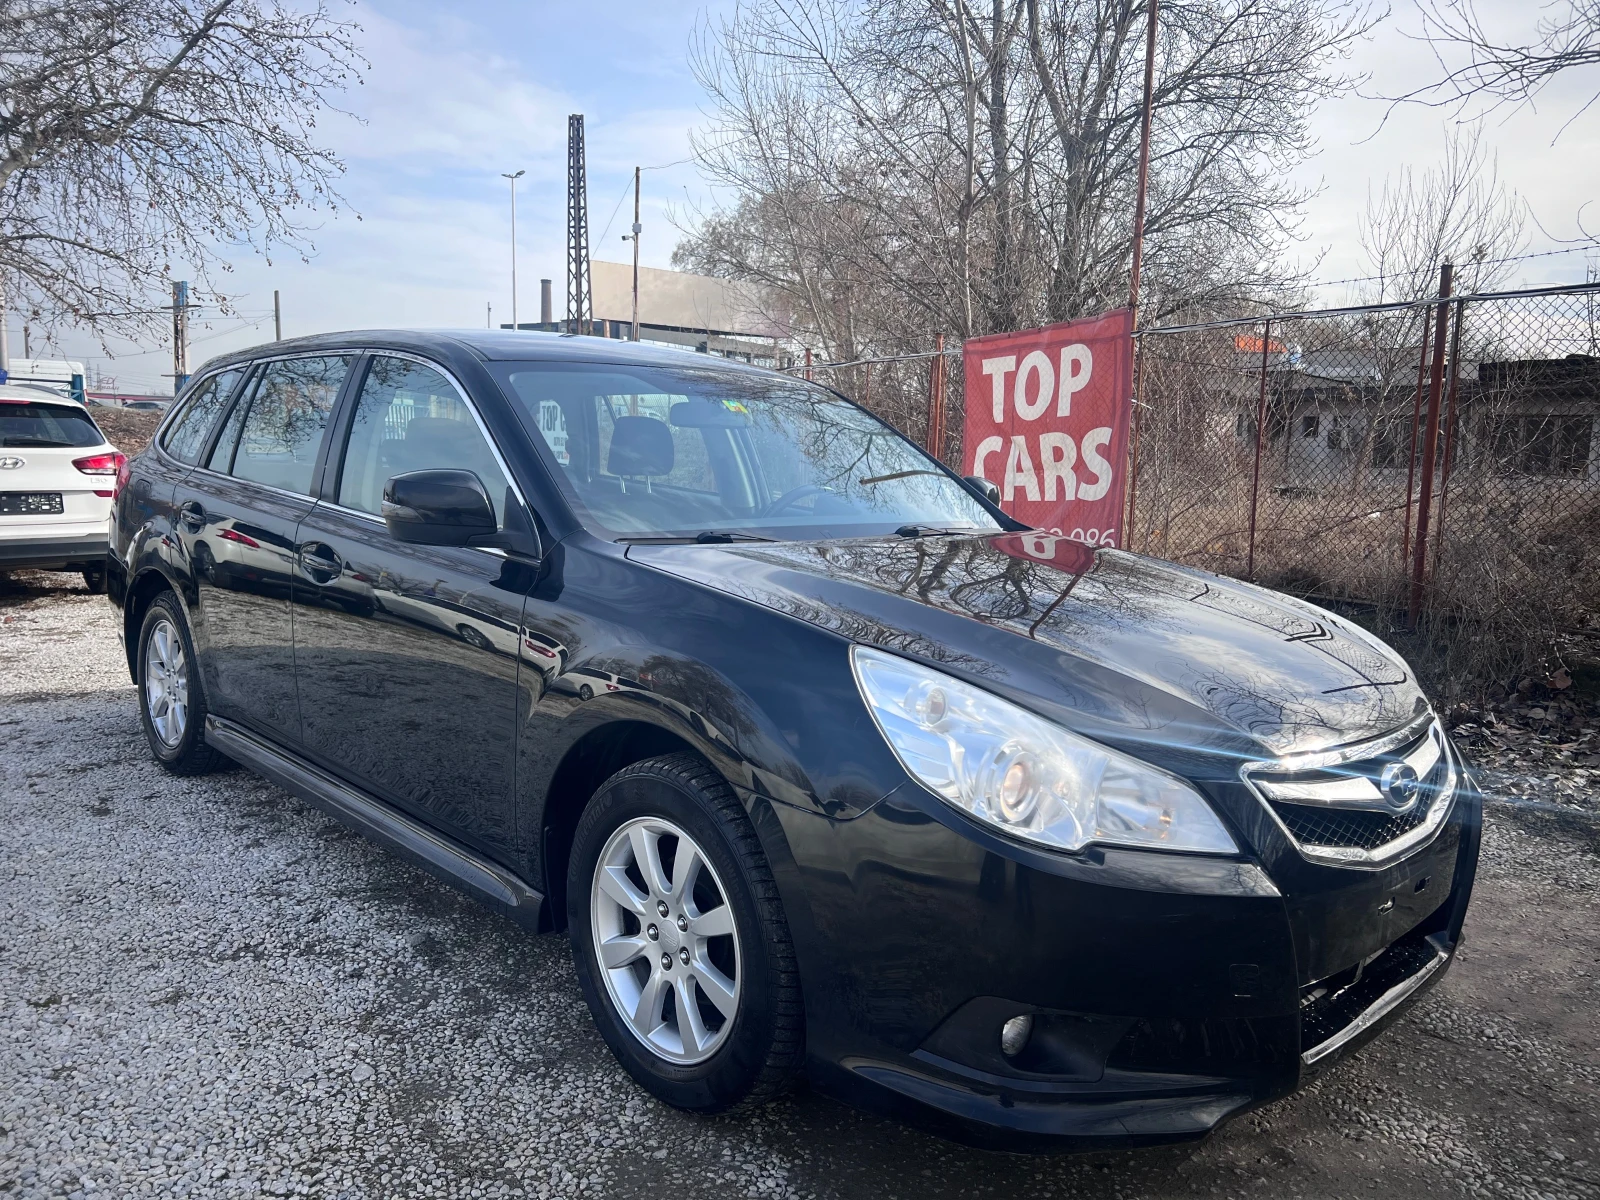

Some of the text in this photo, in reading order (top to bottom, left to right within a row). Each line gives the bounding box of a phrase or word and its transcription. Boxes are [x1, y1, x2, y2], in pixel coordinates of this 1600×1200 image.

[541, 405, 558, 431] TOP
[982, 343, 1093, 423] TOP
[973, 427, 1113, 501] CARS
